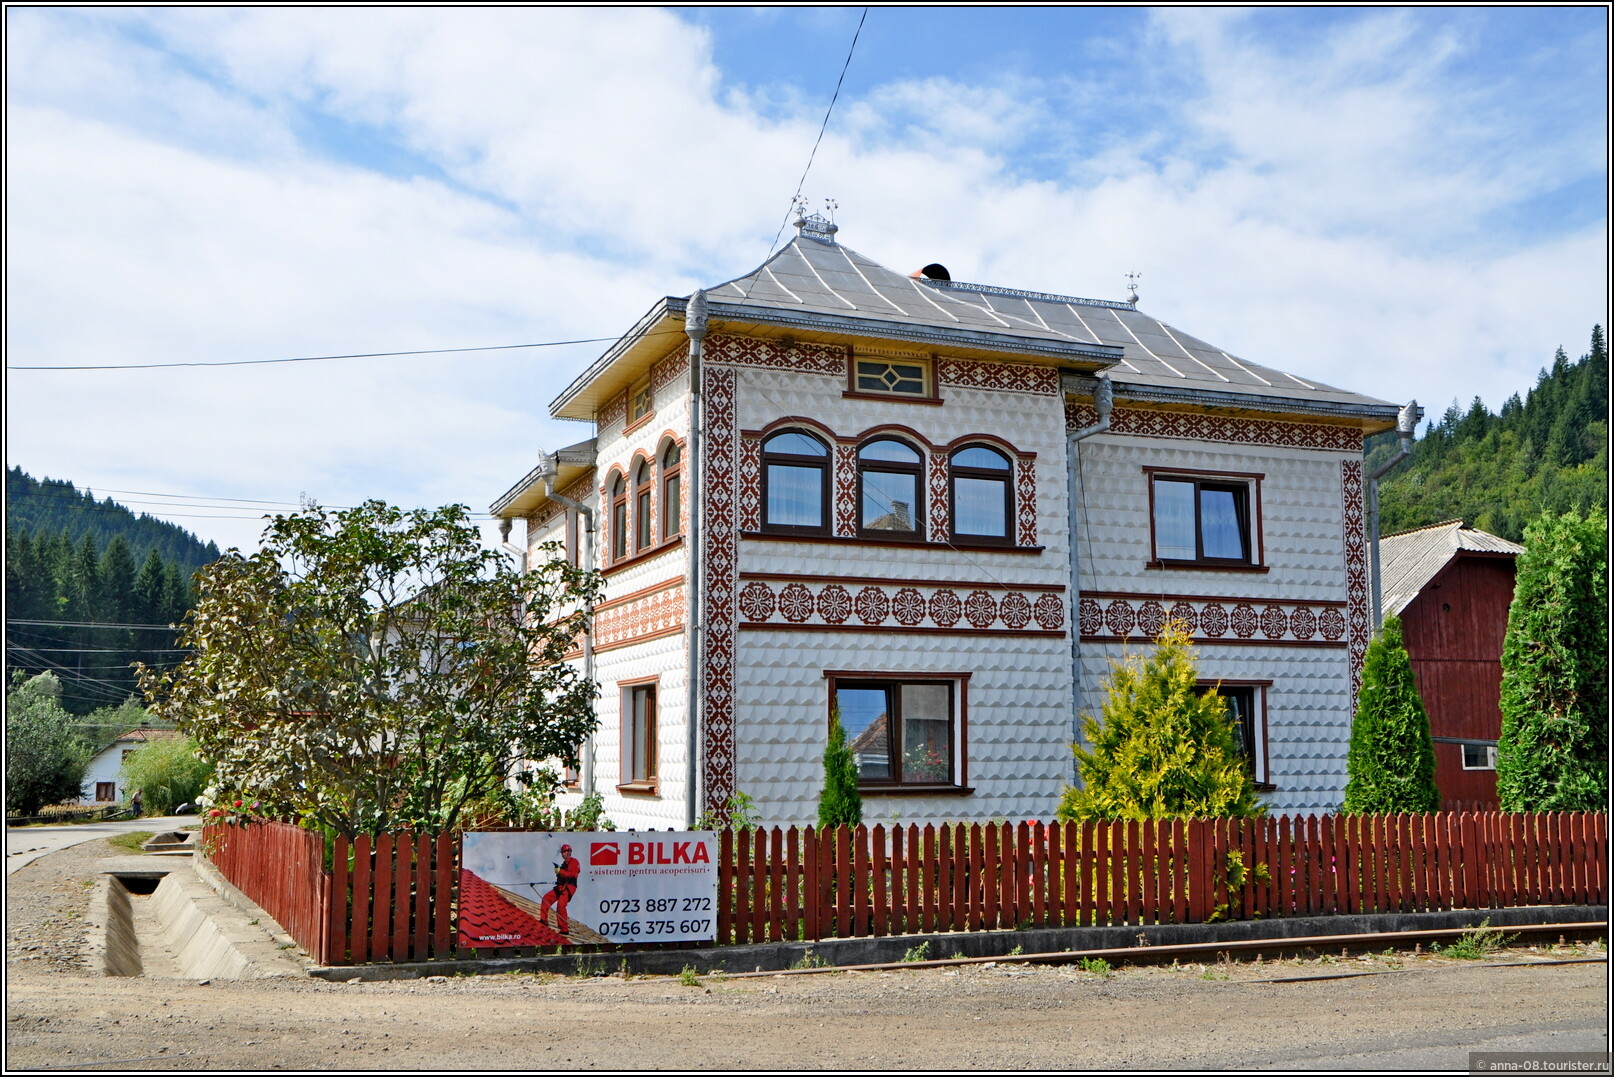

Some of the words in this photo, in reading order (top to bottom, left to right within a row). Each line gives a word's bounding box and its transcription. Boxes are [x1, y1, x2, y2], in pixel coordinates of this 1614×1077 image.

[628, 842, 710, 864] BILKA
[594, 868, 626, 876] sisteme
[629, 868, 657, 877] pentru
[599, 899, 640, 913] 0723
[645, 898, 677, 912] 887
[682, 897, 711, 911] 272
[599, 922, 640, 936] 0756
[646, 921, 675, 934] 375
[680, 919, 711, 933] 607
